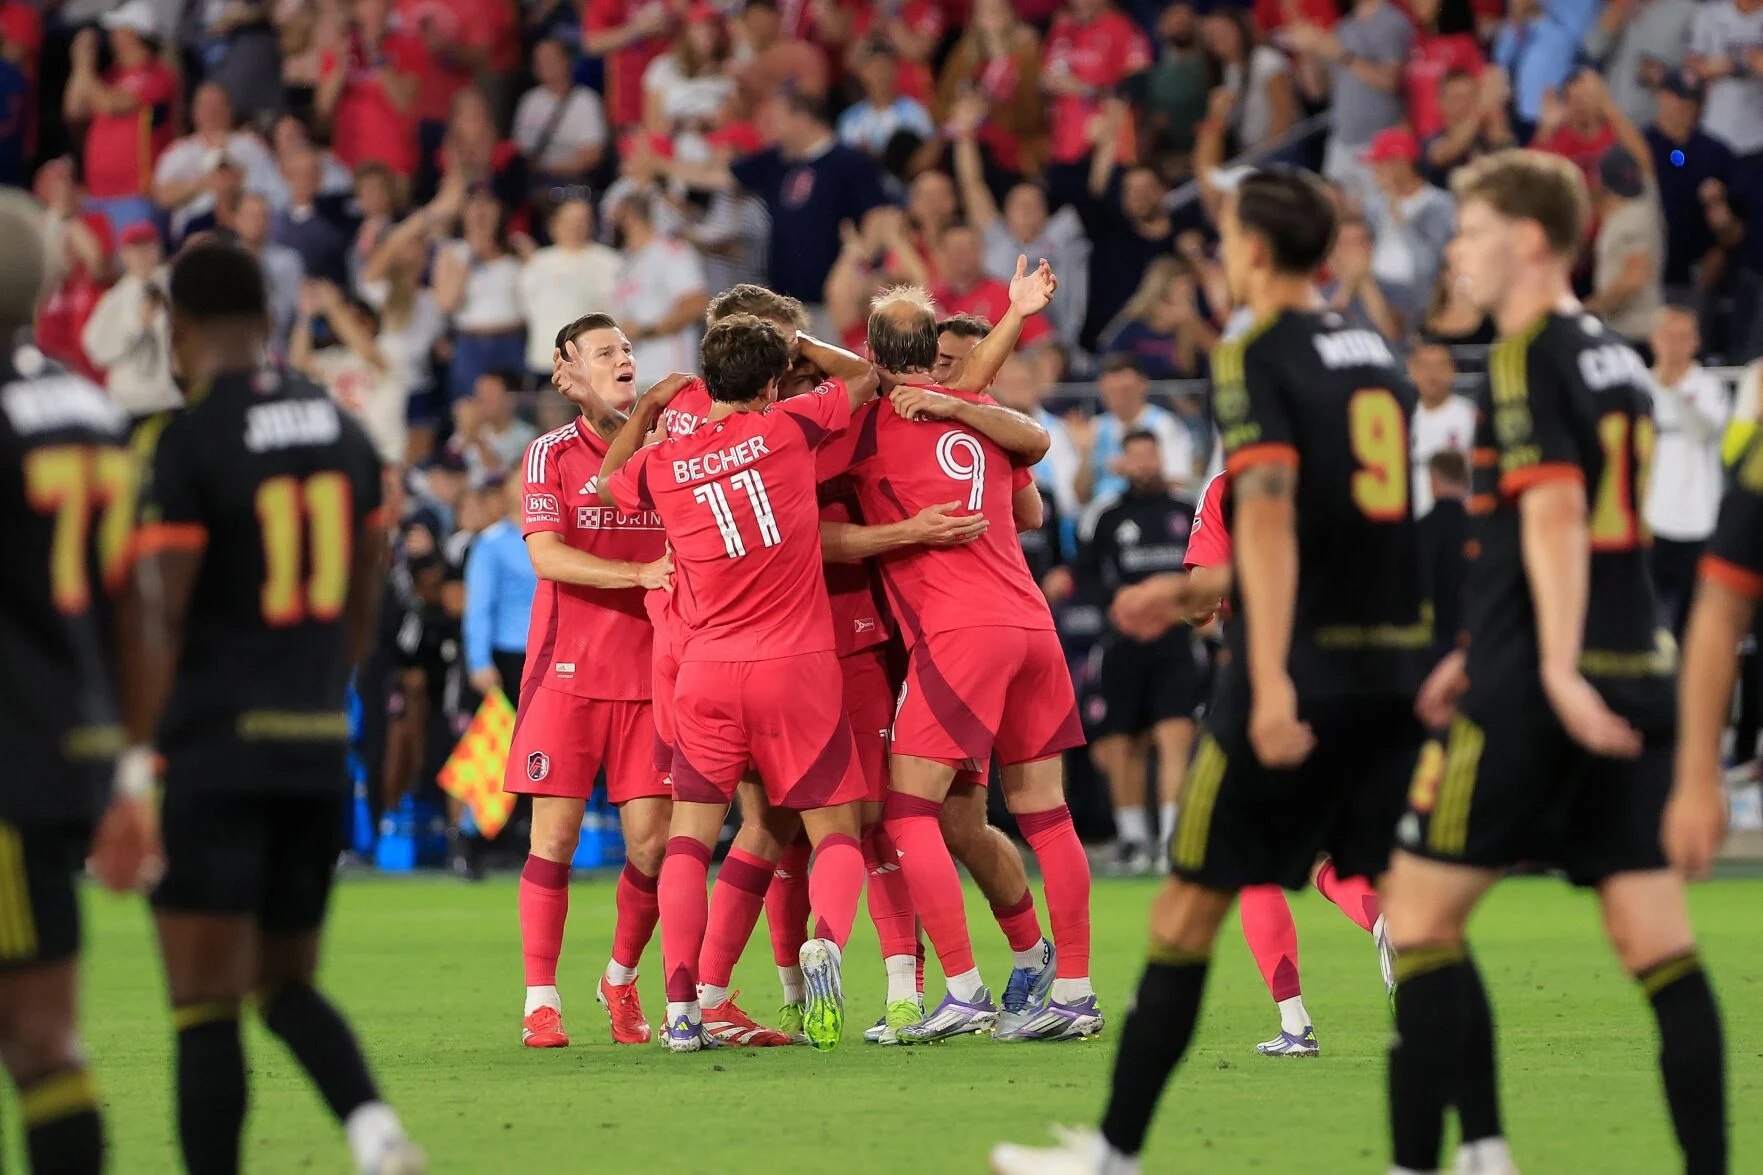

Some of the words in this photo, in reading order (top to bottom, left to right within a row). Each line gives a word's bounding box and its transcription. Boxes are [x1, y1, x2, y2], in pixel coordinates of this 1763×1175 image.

[673, 435, 770, 484] BECHER
[935, 429, 986, 510] 9
[1347, 387, 1408, 521] 9
[526, 514, 560, 524] HealthCare
[529, 497, 554, 512] BJC
[692, 468, 782, 559] 11
[257, 471, 353, 626] 11
